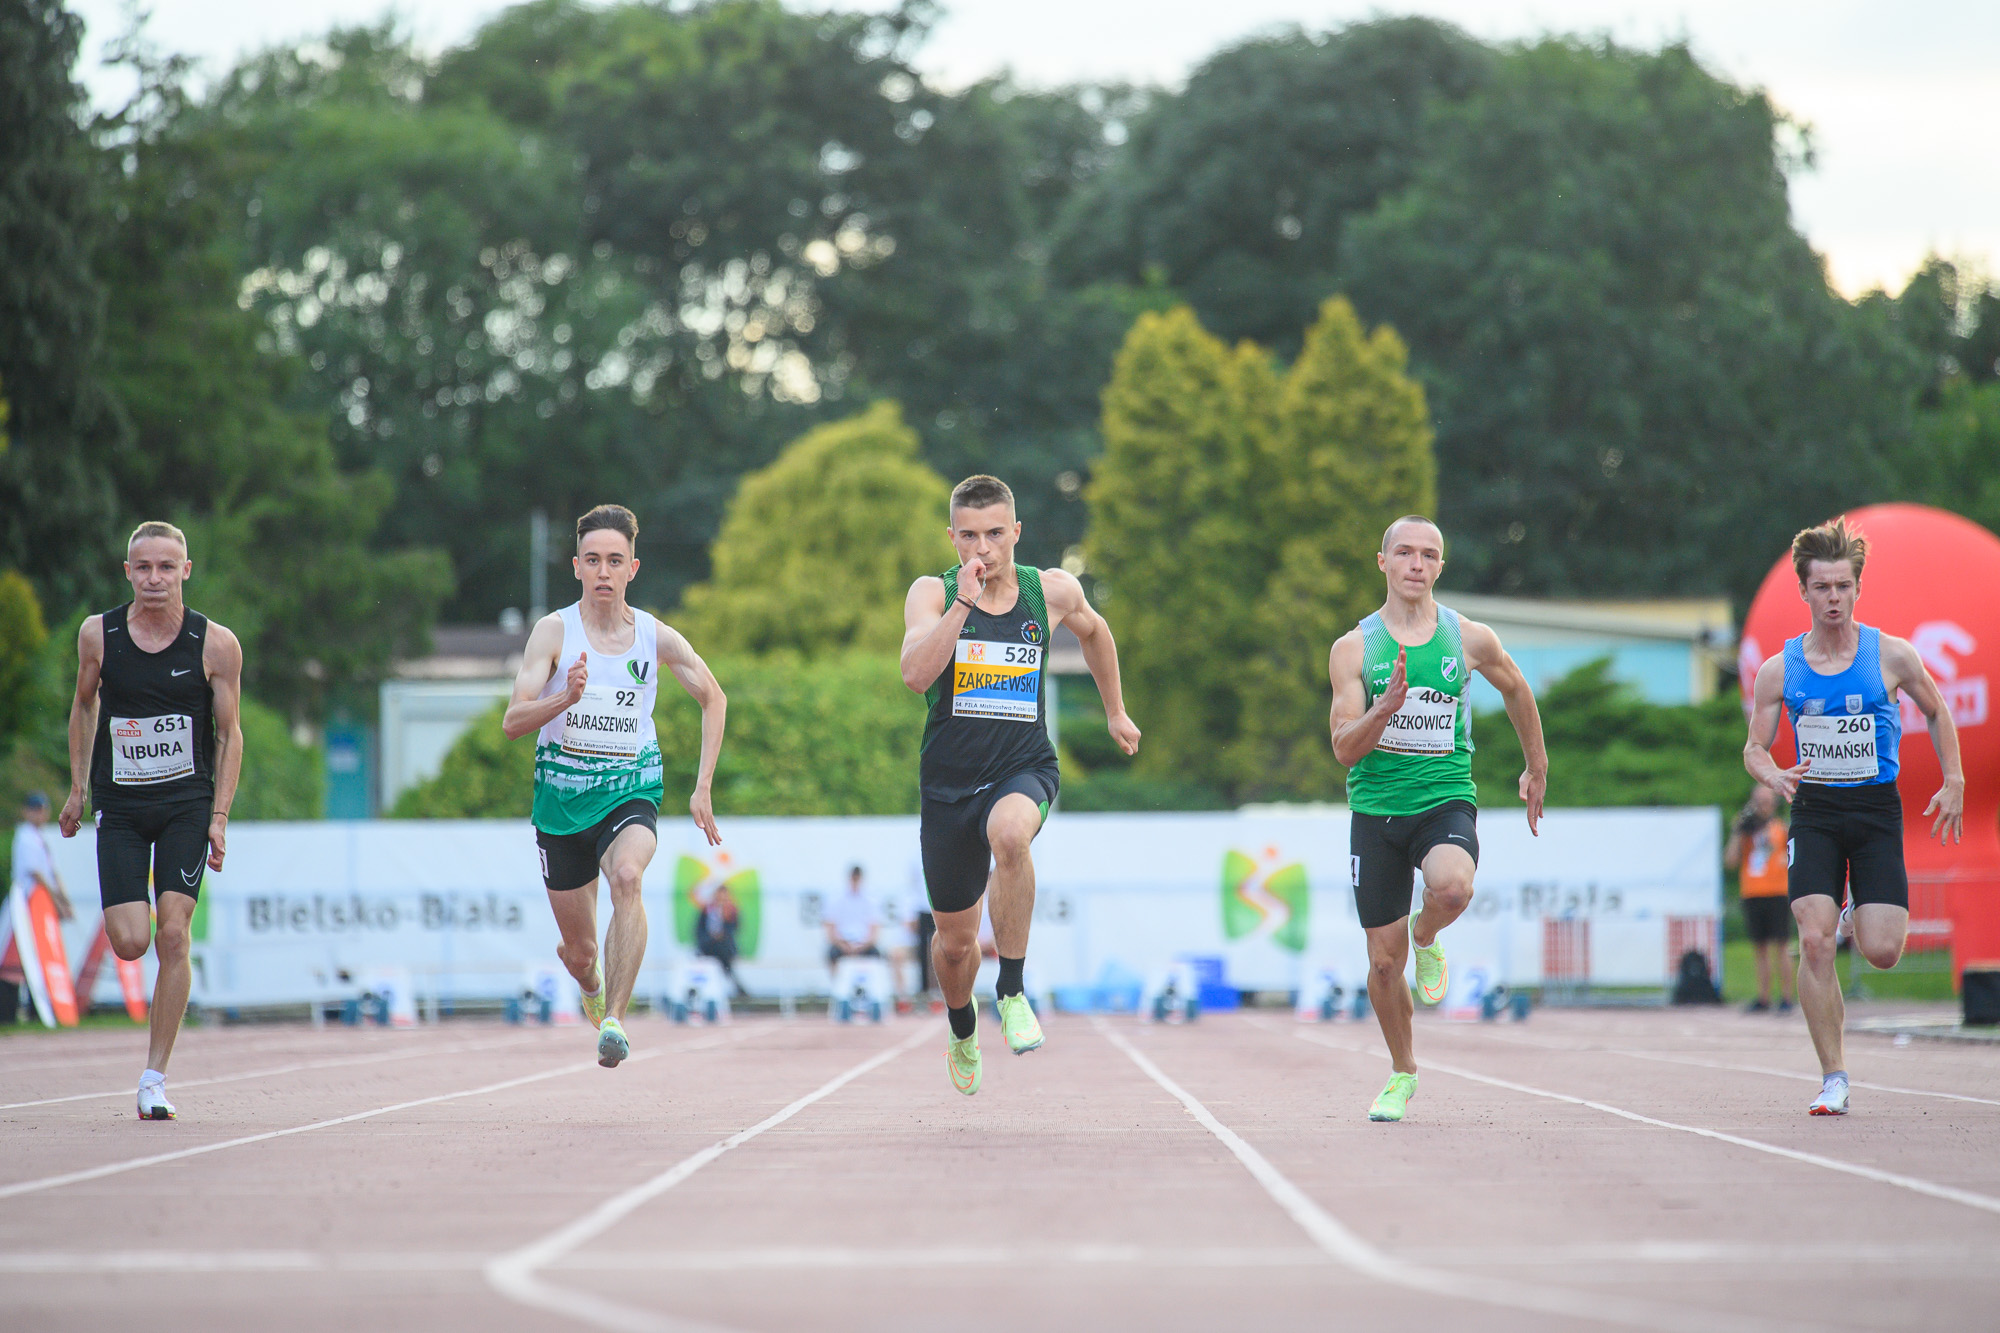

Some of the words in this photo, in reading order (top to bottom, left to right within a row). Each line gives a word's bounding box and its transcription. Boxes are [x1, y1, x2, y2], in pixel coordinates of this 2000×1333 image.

[1004, 646, 1037, 664] 528
[957, 671, 1036, 694] ZAKRZEWSKI
[615, 690, 636, 707] 92
[1418, 690, 1454, 704] 403
[979, 703, 1012, 711] Mistrzostwa
[153, 715, 188, 733] 651
[566, 711, 638, 734] BAJRASZEWSKI
[1836, 717, 1871, 734] 260
[122, 741, 184, 760] LIBURA
[584, 742, 614, 750] Mistrzostwa
[1801, 741, 1874, 760] SZYMAŃSKI
